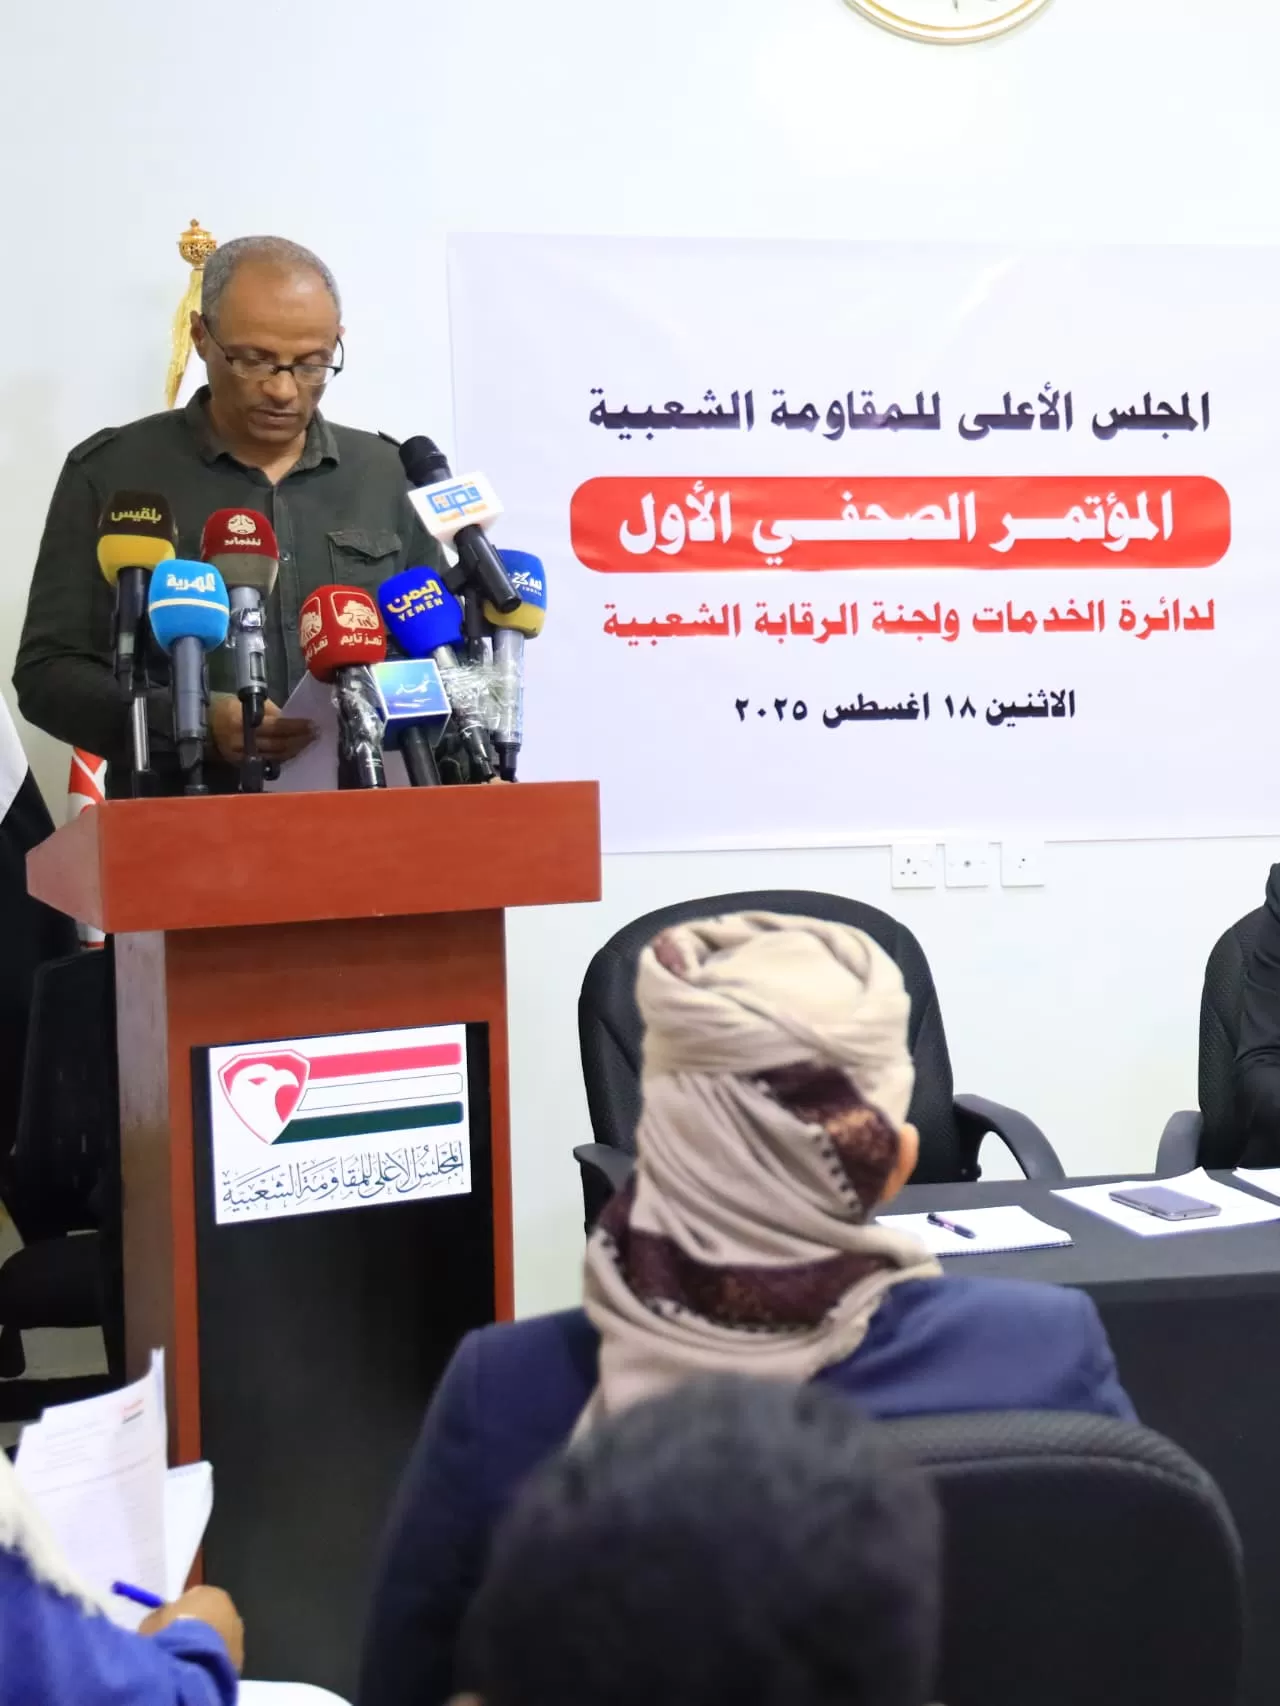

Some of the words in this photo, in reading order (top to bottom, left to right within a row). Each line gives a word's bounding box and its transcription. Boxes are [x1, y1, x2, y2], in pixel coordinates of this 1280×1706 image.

[588, 388, 755, 441] الشعبية
[770, 389, 941, 441] للمقاومة
[958, 382, 1073, 441] الأعلى
[1092, 391, 1210, 441] المجلس
[111, 508, 163, 525] بلقيس
[619, 480, 733, 555] الأول
[751, 490, 977, 565] الصحفي
[990, 490, 1173, 553] المؤتمر
[166, 573, 216, 593] المهرية
[386, 579, 443, 614] اليمن
[398, 597, 444, 622] YEMEN
[603, 603, 742, 647] الشعبية
[754, 602, 859, 645] الرقابة
[871, 601, 961, 643] ولجنة
[971, 599, 1106, 635] الخدمات
[1118, 599, 1216, 641] لدائرة
[340, 632, 364, 647] تايم
[364, 635, 383, 646] تعز
[735, 698, 808, 722] ٢٠٢٥
[822, 692, 930, 729] اغسطس
[944, 695, 977, 718] ١٨
[985, 689, 1076, 728] الاثنين
